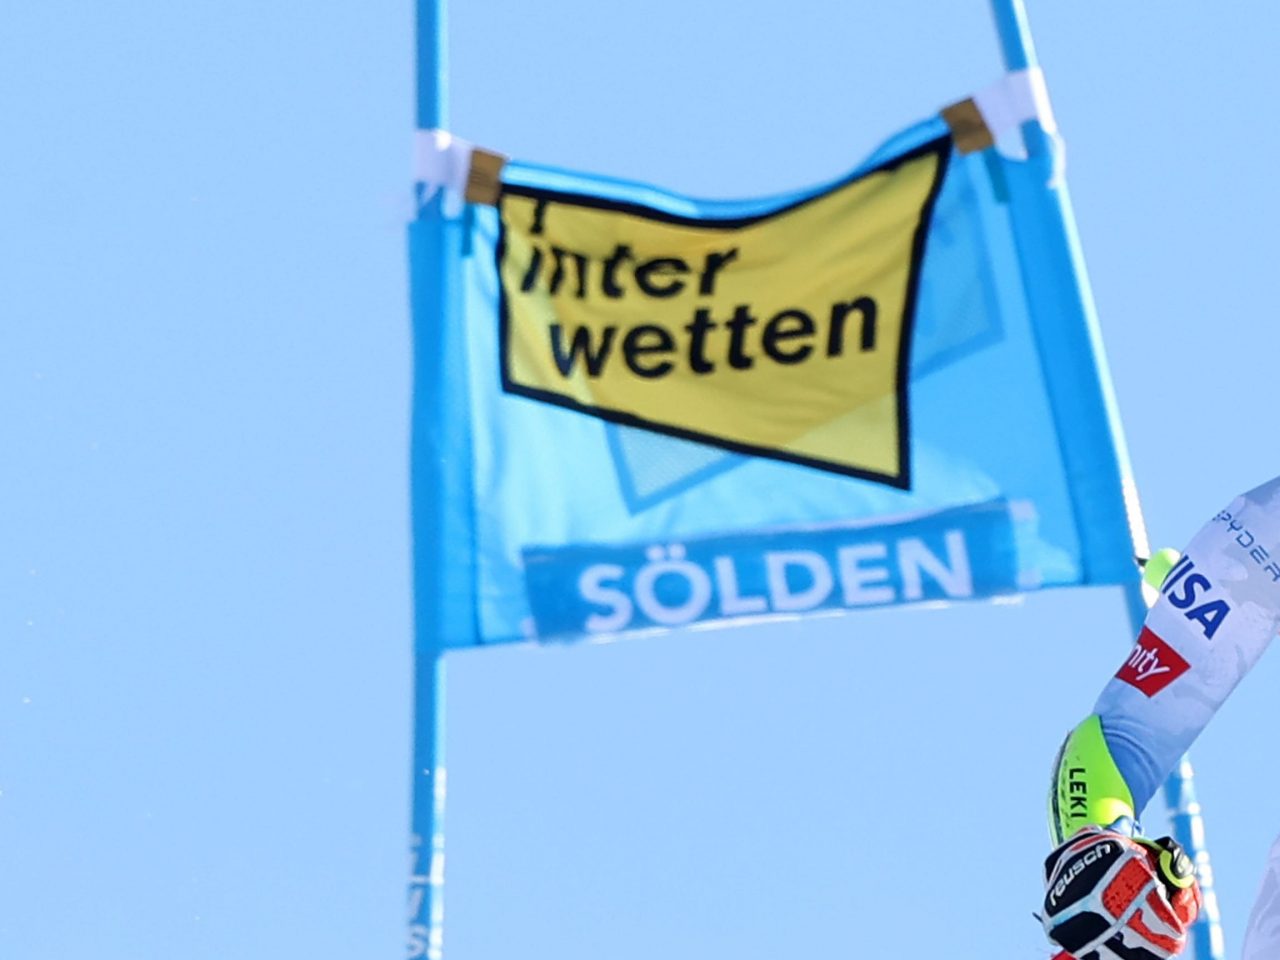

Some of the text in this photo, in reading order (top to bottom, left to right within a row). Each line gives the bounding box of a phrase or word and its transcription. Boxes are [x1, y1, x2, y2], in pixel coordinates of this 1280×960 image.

[549, 296, 878, 379] wetten
[577, 529, 975, 635] SÖLDEN
[1069, 767, 1088, 818] LEKI
[1050, 843, 1111, 907] reusch
